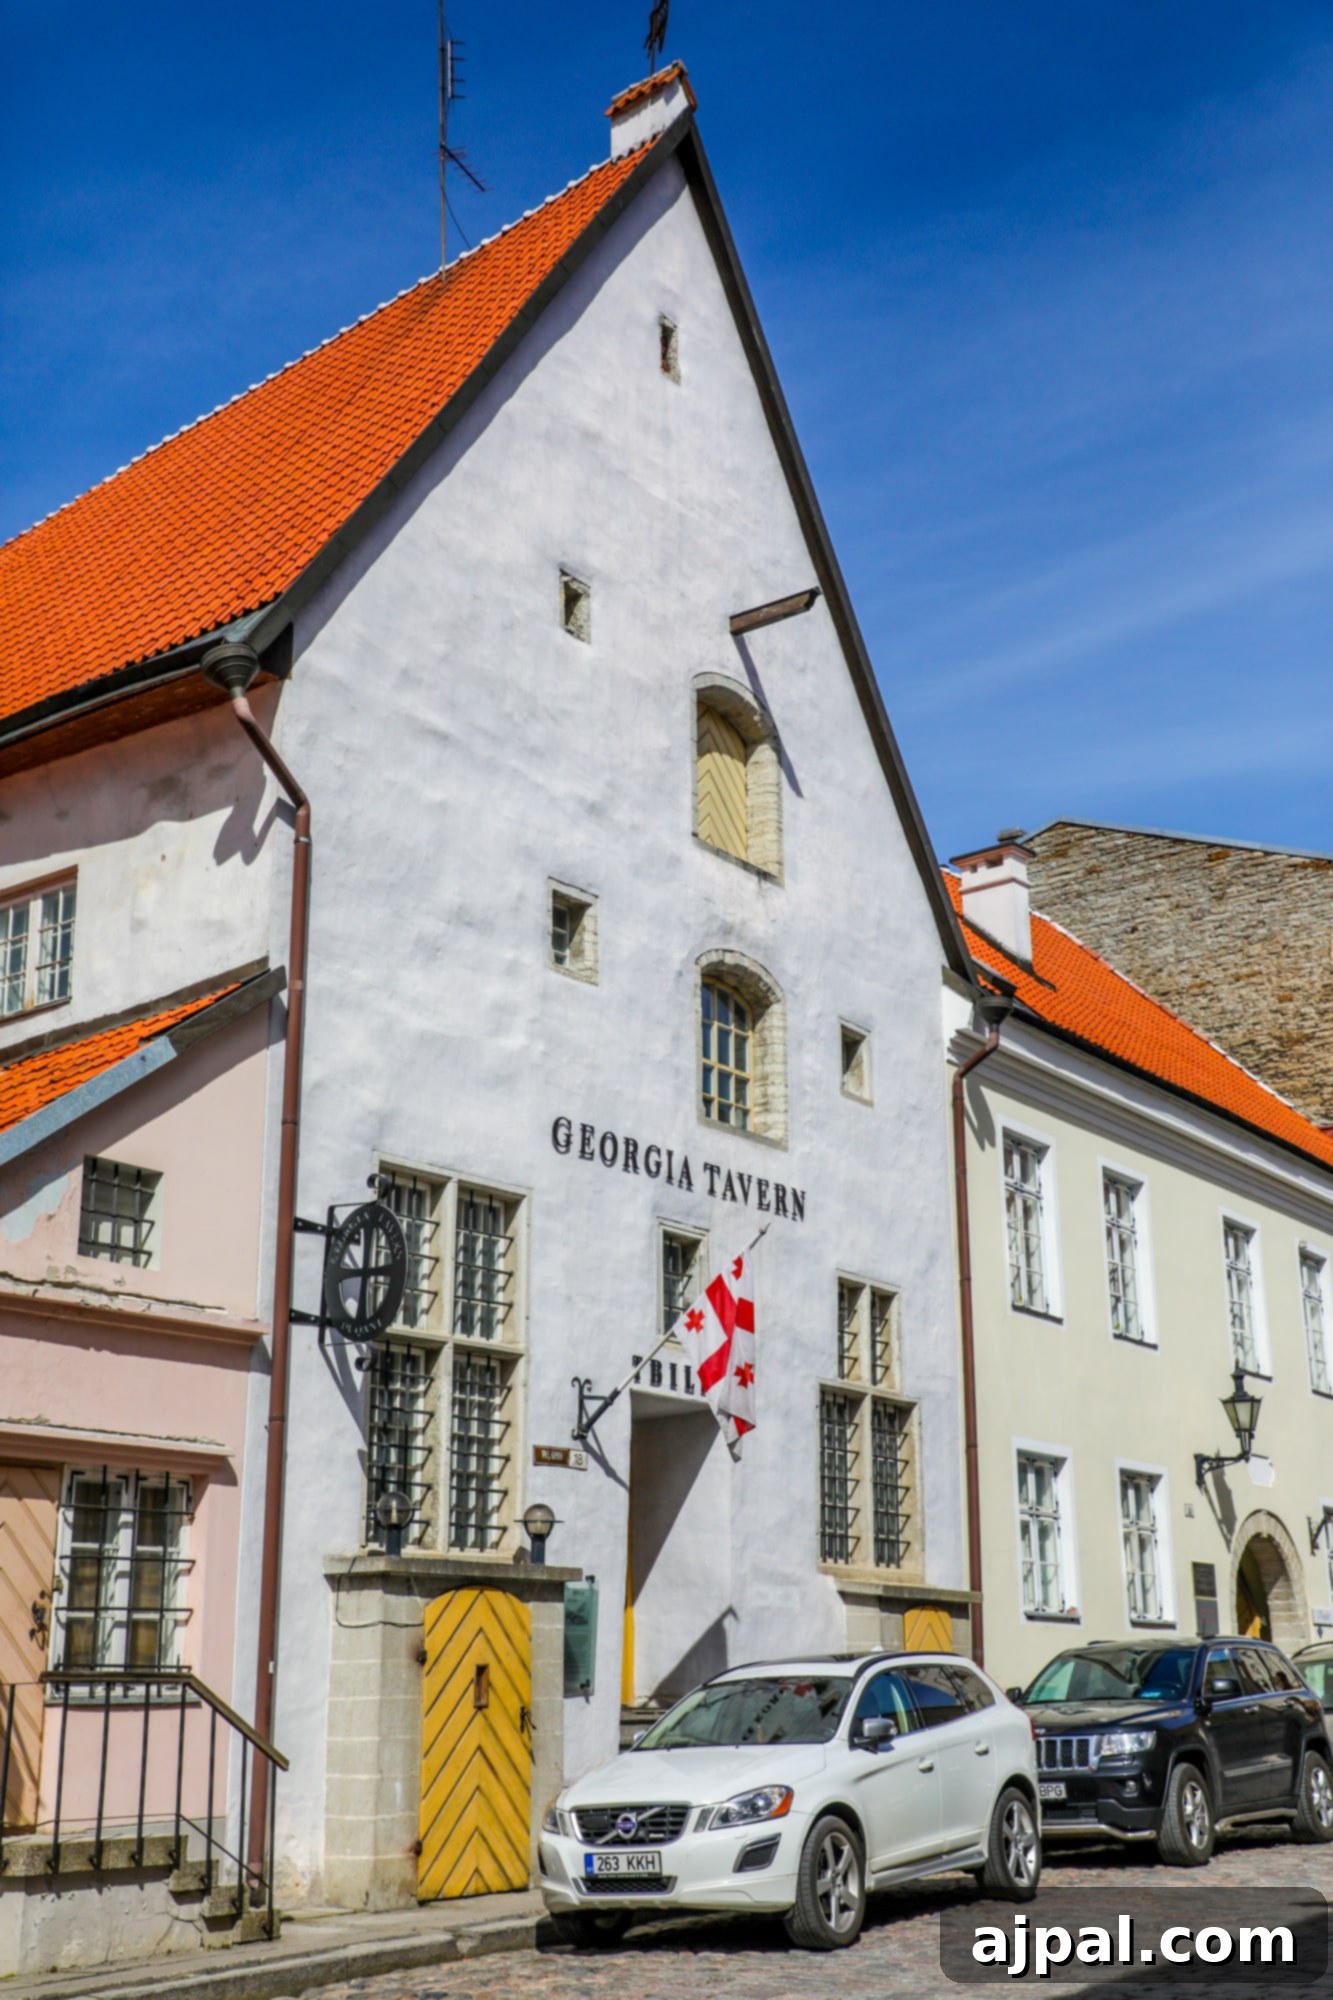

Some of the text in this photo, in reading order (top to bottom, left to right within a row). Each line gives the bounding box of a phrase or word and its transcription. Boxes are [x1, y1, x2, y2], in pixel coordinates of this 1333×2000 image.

[551, 1116, 807, 1222] GEORGIA TAVERN
[632, 1355, 706, 1397] TBIL
[574, 1452, 583, 1466] 18
[597, 1854, 656, 1872] 263 KKH
